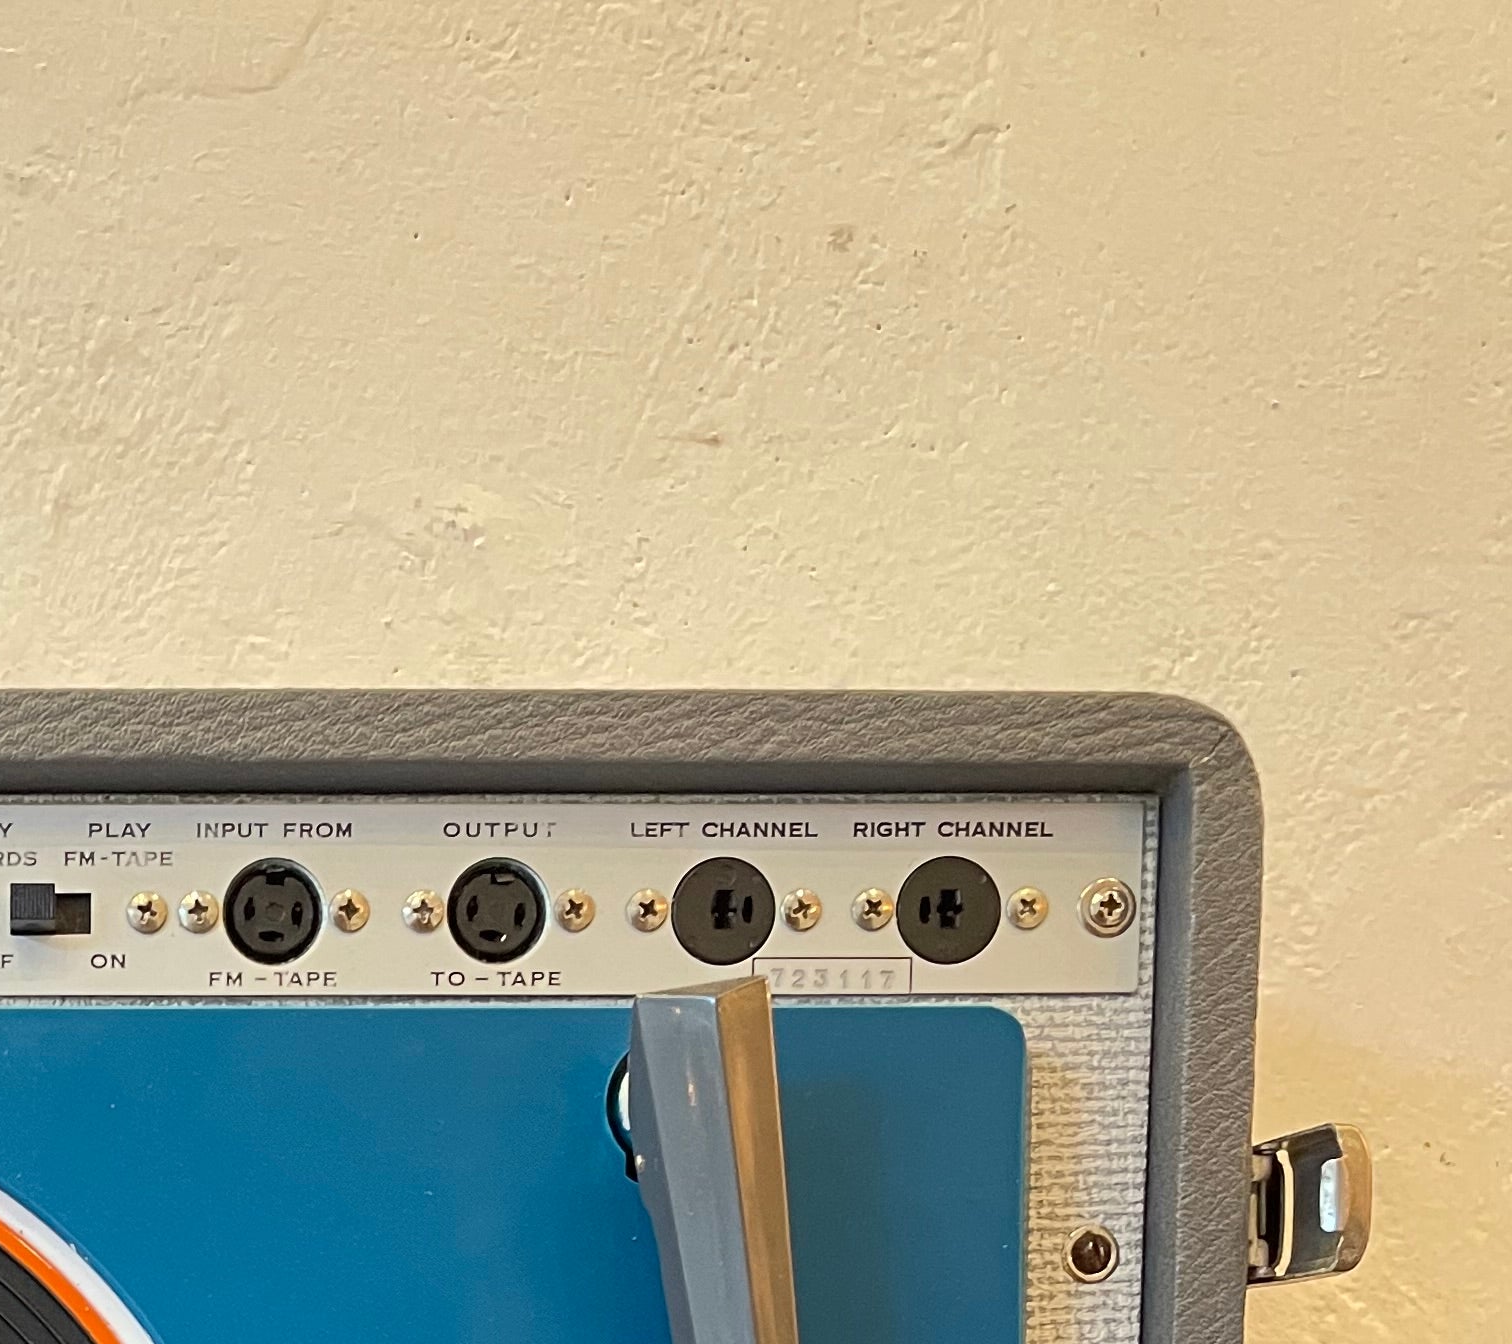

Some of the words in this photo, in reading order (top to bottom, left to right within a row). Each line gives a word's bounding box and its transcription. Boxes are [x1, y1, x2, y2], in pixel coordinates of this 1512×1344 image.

[88, 822, 152, 839] PLAY
[196, 822, 270, 839] INPUT
[283, 822, 354, 839] FROM
[442, 821, 557, 838] OUTPUT
[630, 821, 691, 838] LEFT
[701, 821, 819, 838] CHANNEL
[852, 821, 927, 838] RIGHT
[937, 820, 1054, 838] CHANNEL
[64, 850, 174, 867] FM-TAPE
[90, 953, 127, 970] ON
[769, 967, 896, 990] 723117
